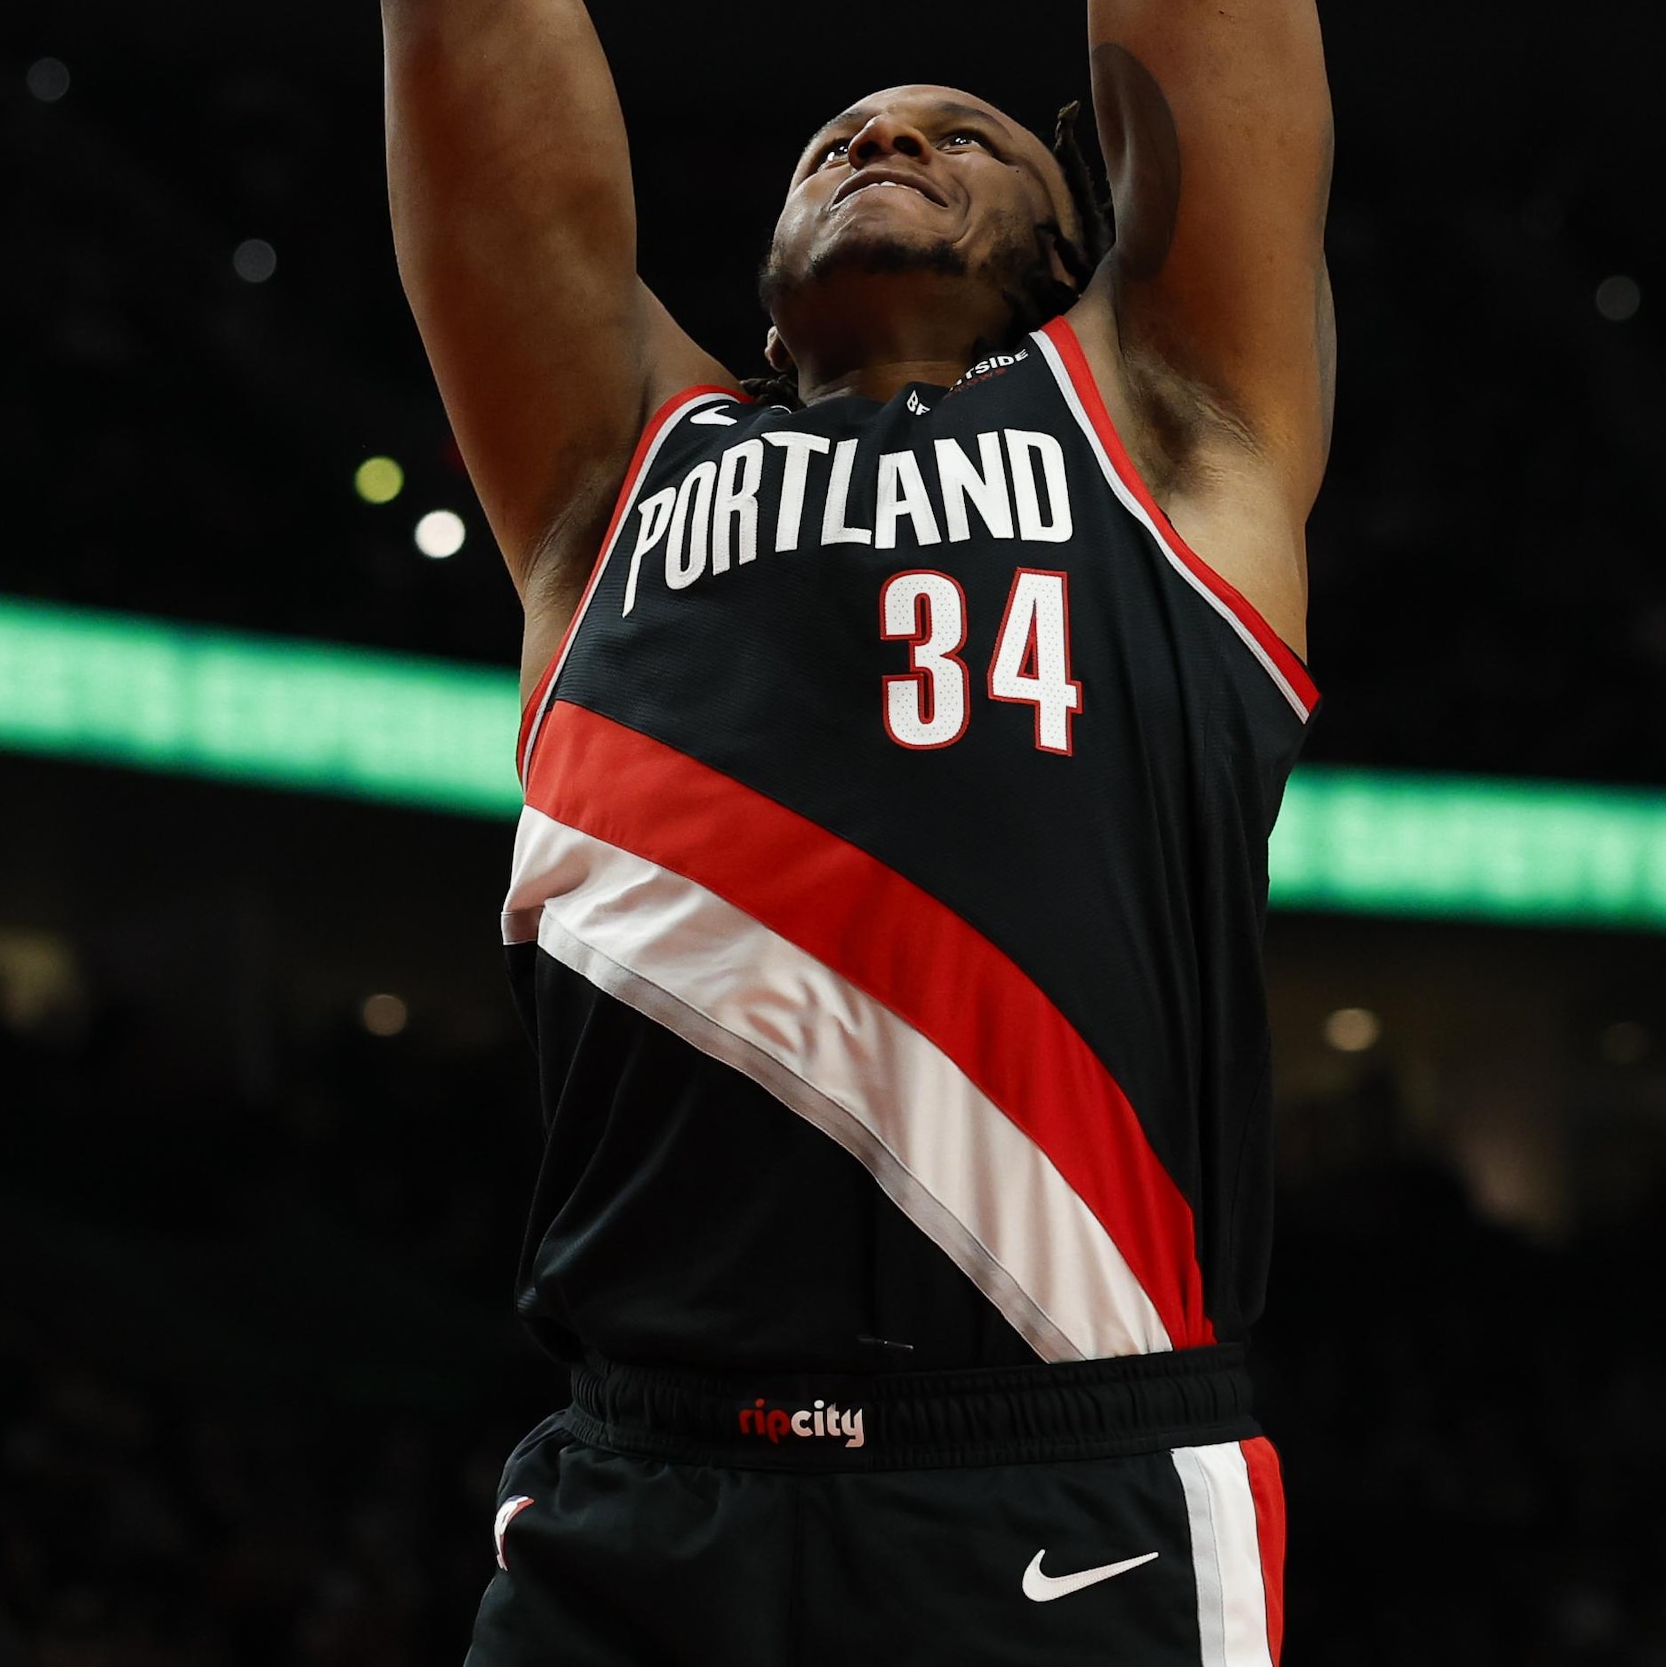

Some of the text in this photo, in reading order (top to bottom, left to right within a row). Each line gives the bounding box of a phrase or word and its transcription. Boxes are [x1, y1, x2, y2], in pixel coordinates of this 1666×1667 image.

[949, 349, 1029, 392] TSIDE
[622, 429, 1073, 618] PORTLAND
[879, 567, 1082, 757] 34
[739, 1398, 865, 1448] ripcity
